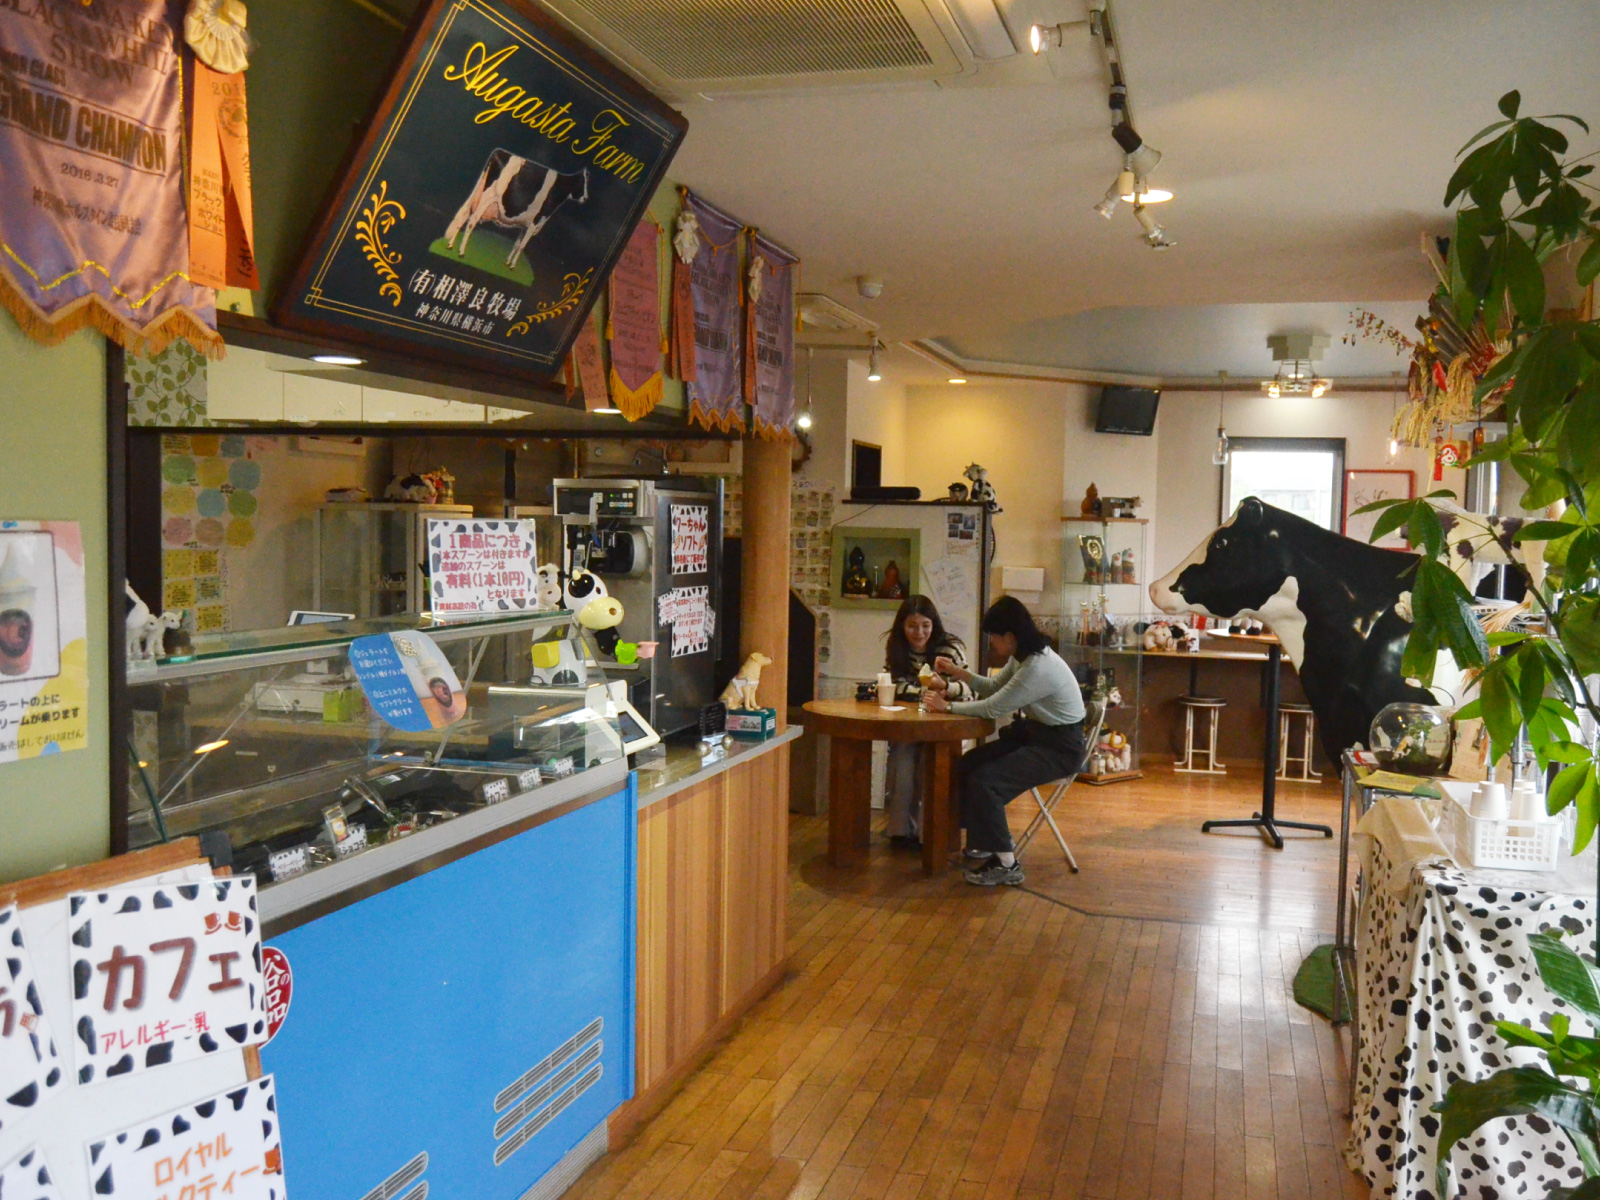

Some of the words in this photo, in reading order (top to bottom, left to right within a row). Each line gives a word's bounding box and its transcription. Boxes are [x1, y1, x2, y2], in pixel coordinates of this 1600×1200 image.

[76, 105, 166, 171] CHAMPION
[444, 41, 577, 144] Augasta
[571, 109, 645, 184] Farm
[415, 301, 495, 335] 神奈川県横浜市
[487, 588, 525, 600] となります
[96, 936, 244, 1013] カフェ
[154, 1132, 233, 1187] ロイヤル
